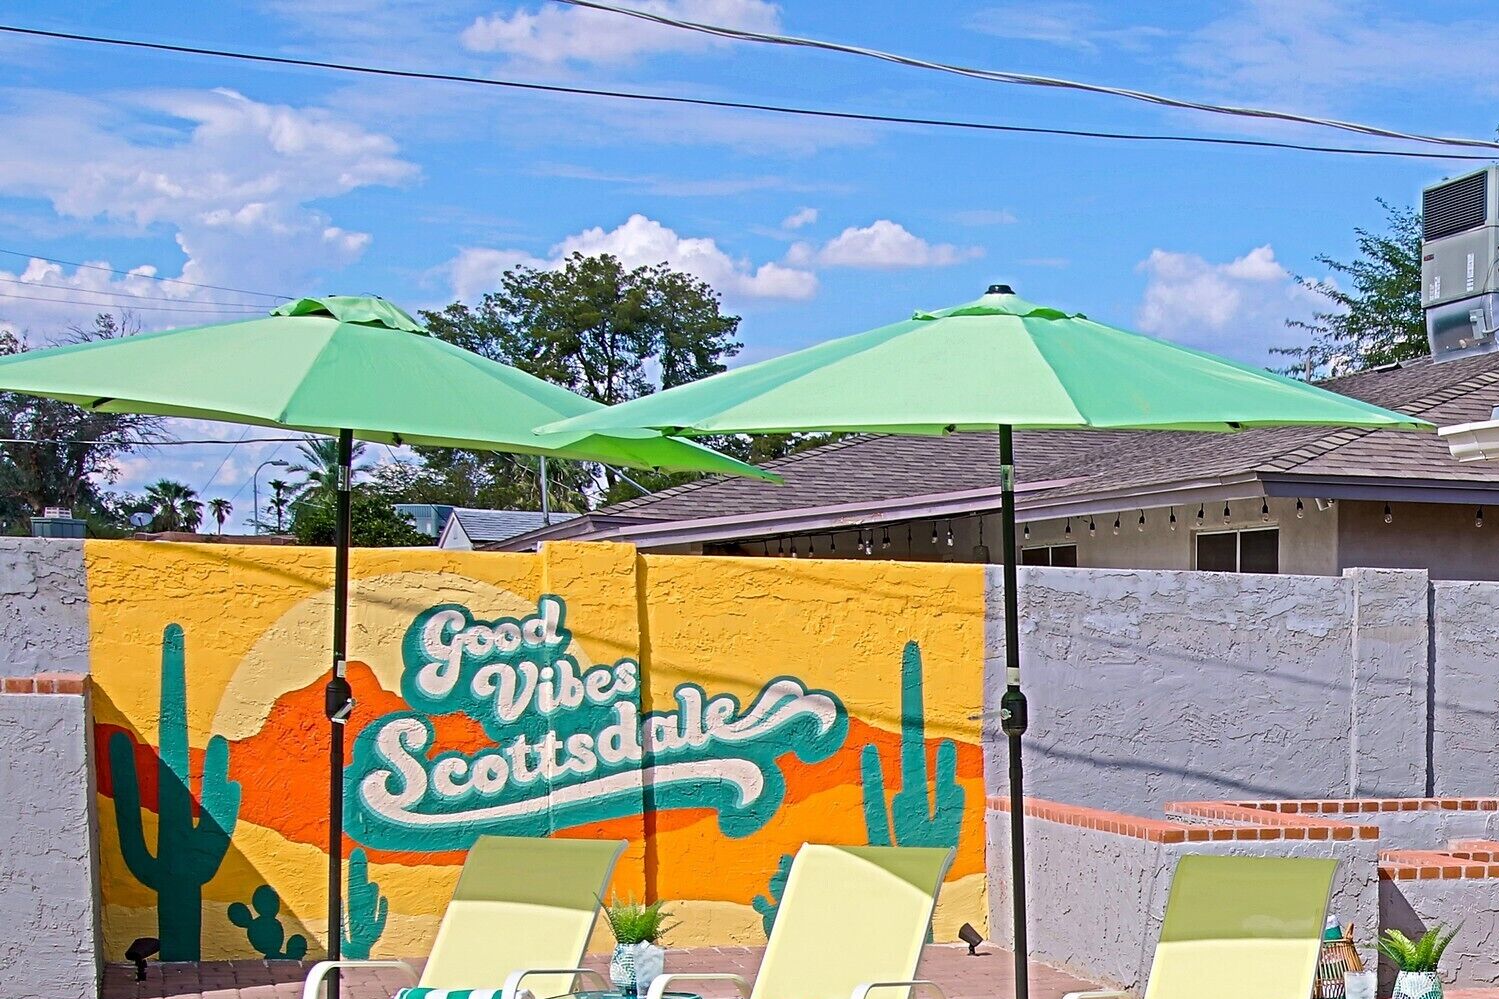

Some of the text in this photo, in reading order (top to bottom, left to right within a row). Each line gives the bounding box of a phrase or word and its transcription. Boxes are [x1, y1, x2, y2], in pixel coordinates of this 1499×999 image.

[418, 599, 564, 698] Good
[470, 660, 637, 721] Vibes
[362, 680, 837, 826] Scottsdale
